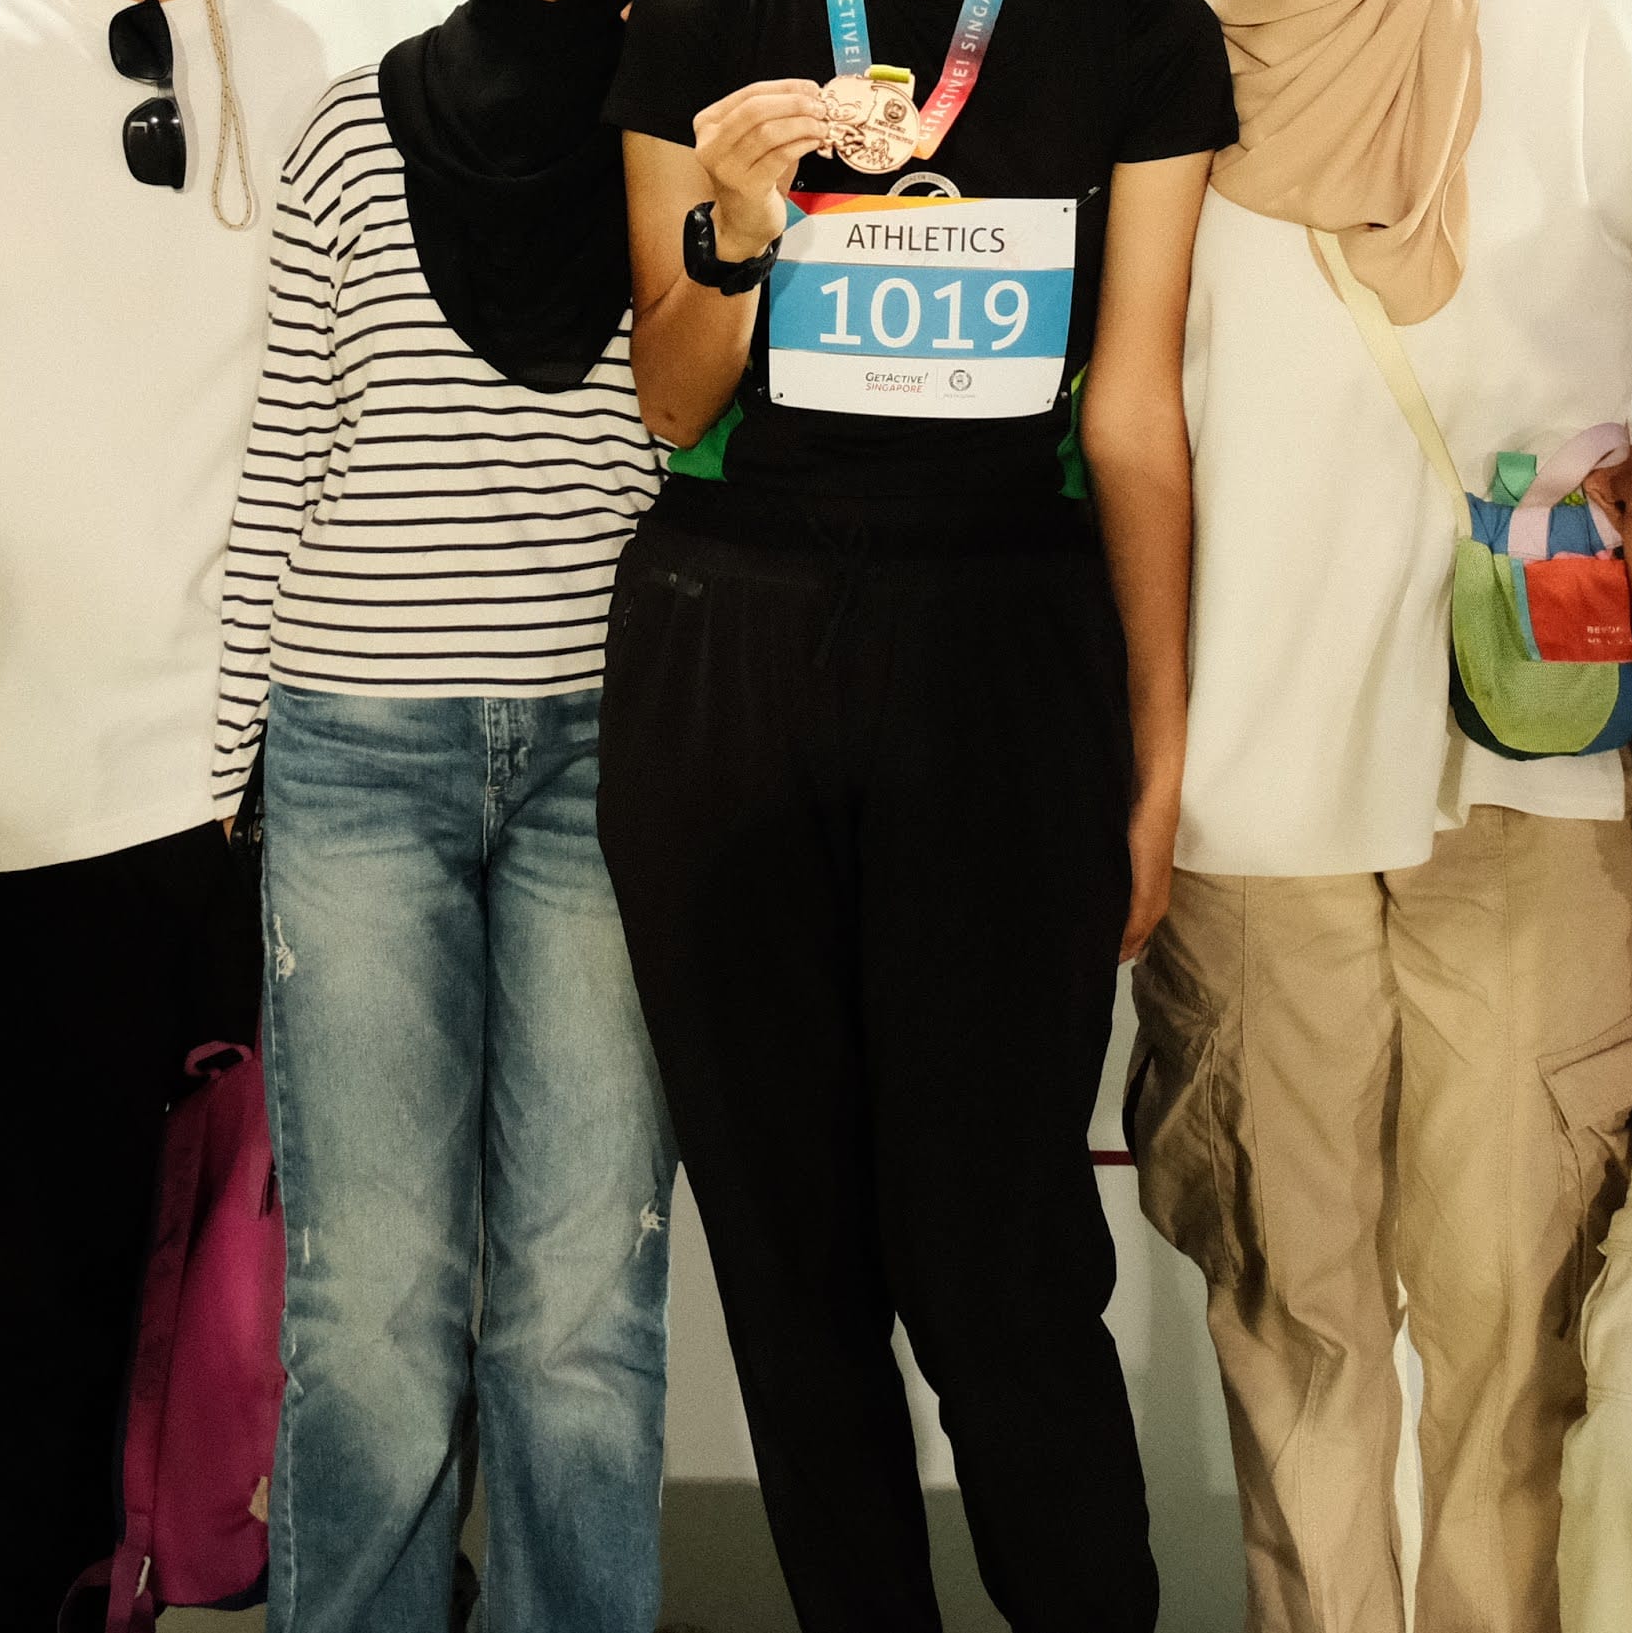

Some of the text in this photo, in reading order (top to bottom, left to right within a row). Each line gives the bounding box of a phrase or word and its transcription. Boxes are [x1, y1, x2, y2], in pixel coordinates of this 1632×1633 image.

[846, 224, 1006, 252] ATHLETICS
[818, 276, 1030, 350] 1019
[866, 382, 923, 393] SINGAPORE
